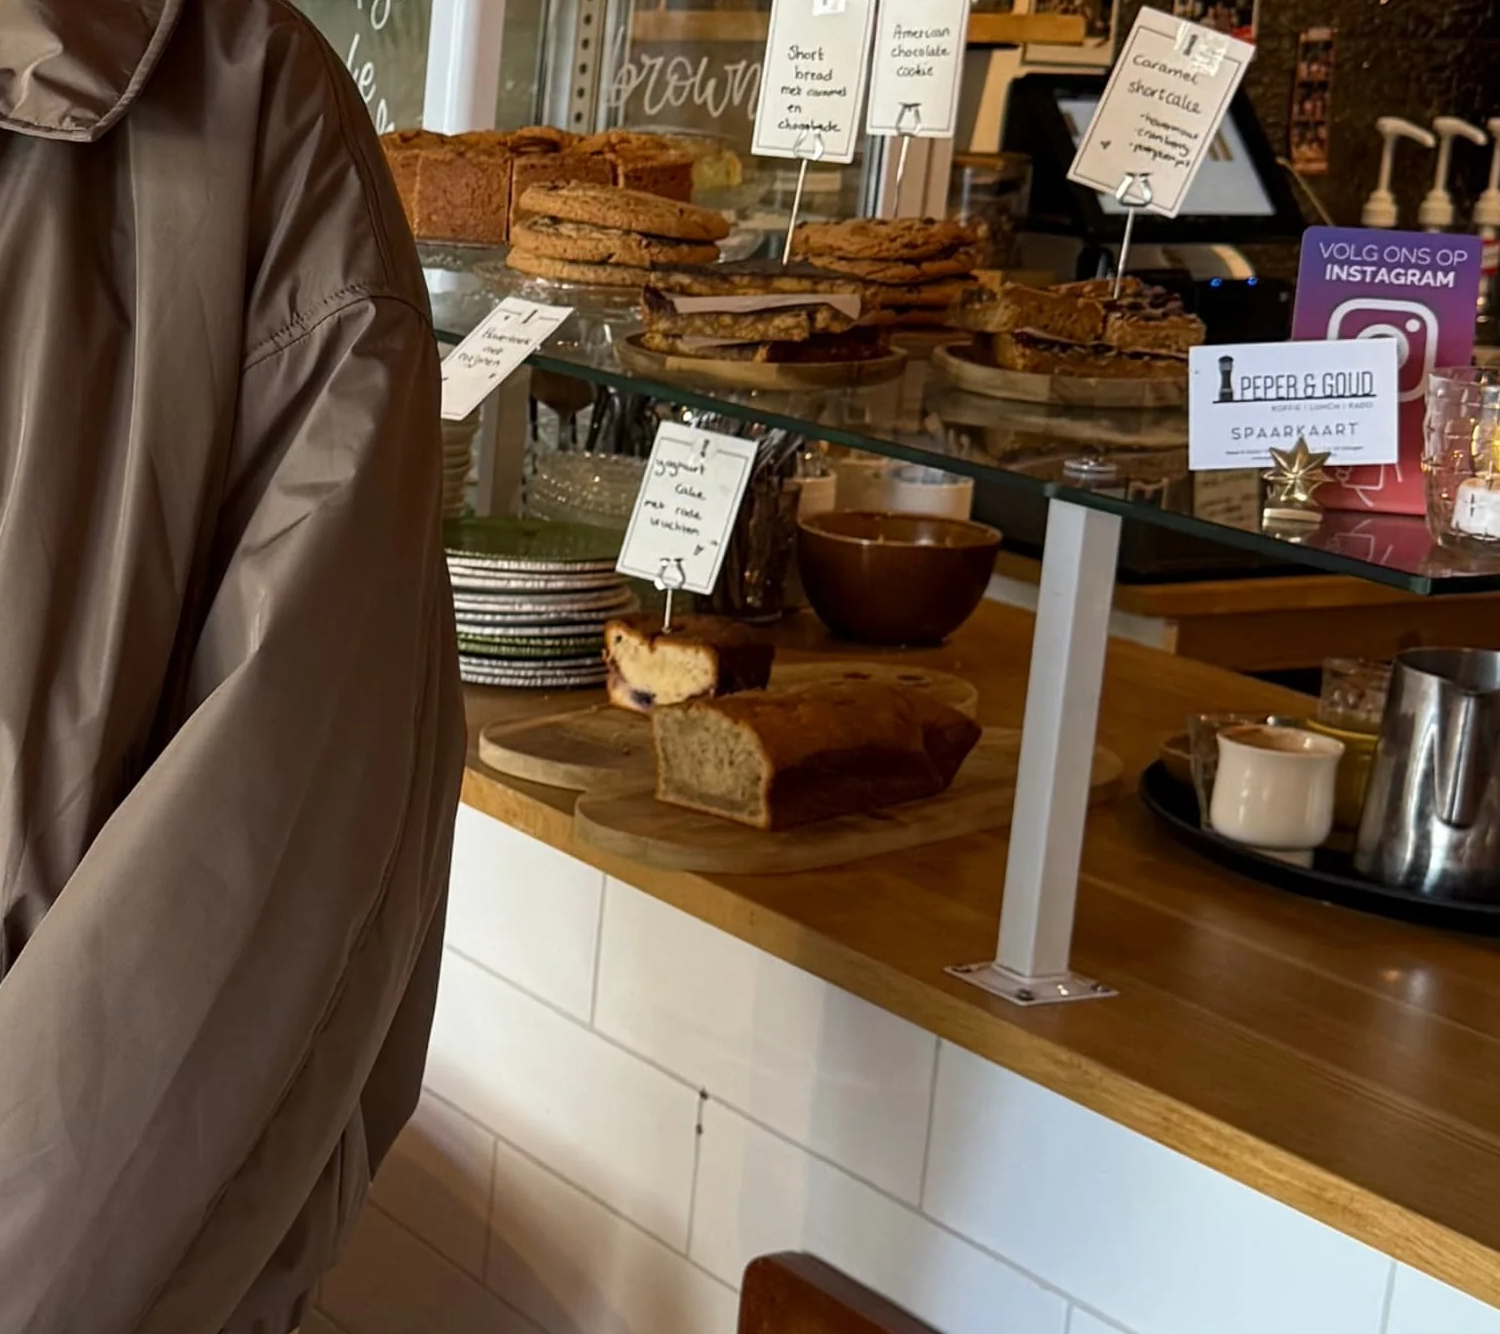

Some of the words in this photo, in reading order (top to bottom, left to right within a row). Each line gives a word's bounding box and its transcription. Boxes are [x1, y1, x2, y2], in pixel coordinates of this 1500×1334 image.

[787, 44, 823, 61] Short
[890, 44, 949, 57] chocolate
[794, 67, 831, 81] bread
[896, 63, 932, 76] cookie
[1132, 54, 1198, 85] Caramel
[1127, 80, 1200, 113] shortcake
[1318, 241, 1377, 261] VOLG
[1383, 245, 1429, 265] ONS
[1435, 249, 1467, 267] OP
[1325, 263, 1455, 287] INSTAGRAM
[1240, 374, 1296, 399] PEPER
[1303, 373, 1314, 397] &
[1322, 370, 1372, 396] GOUD
[1231, 422, 1357, 440] SPAARKAART
